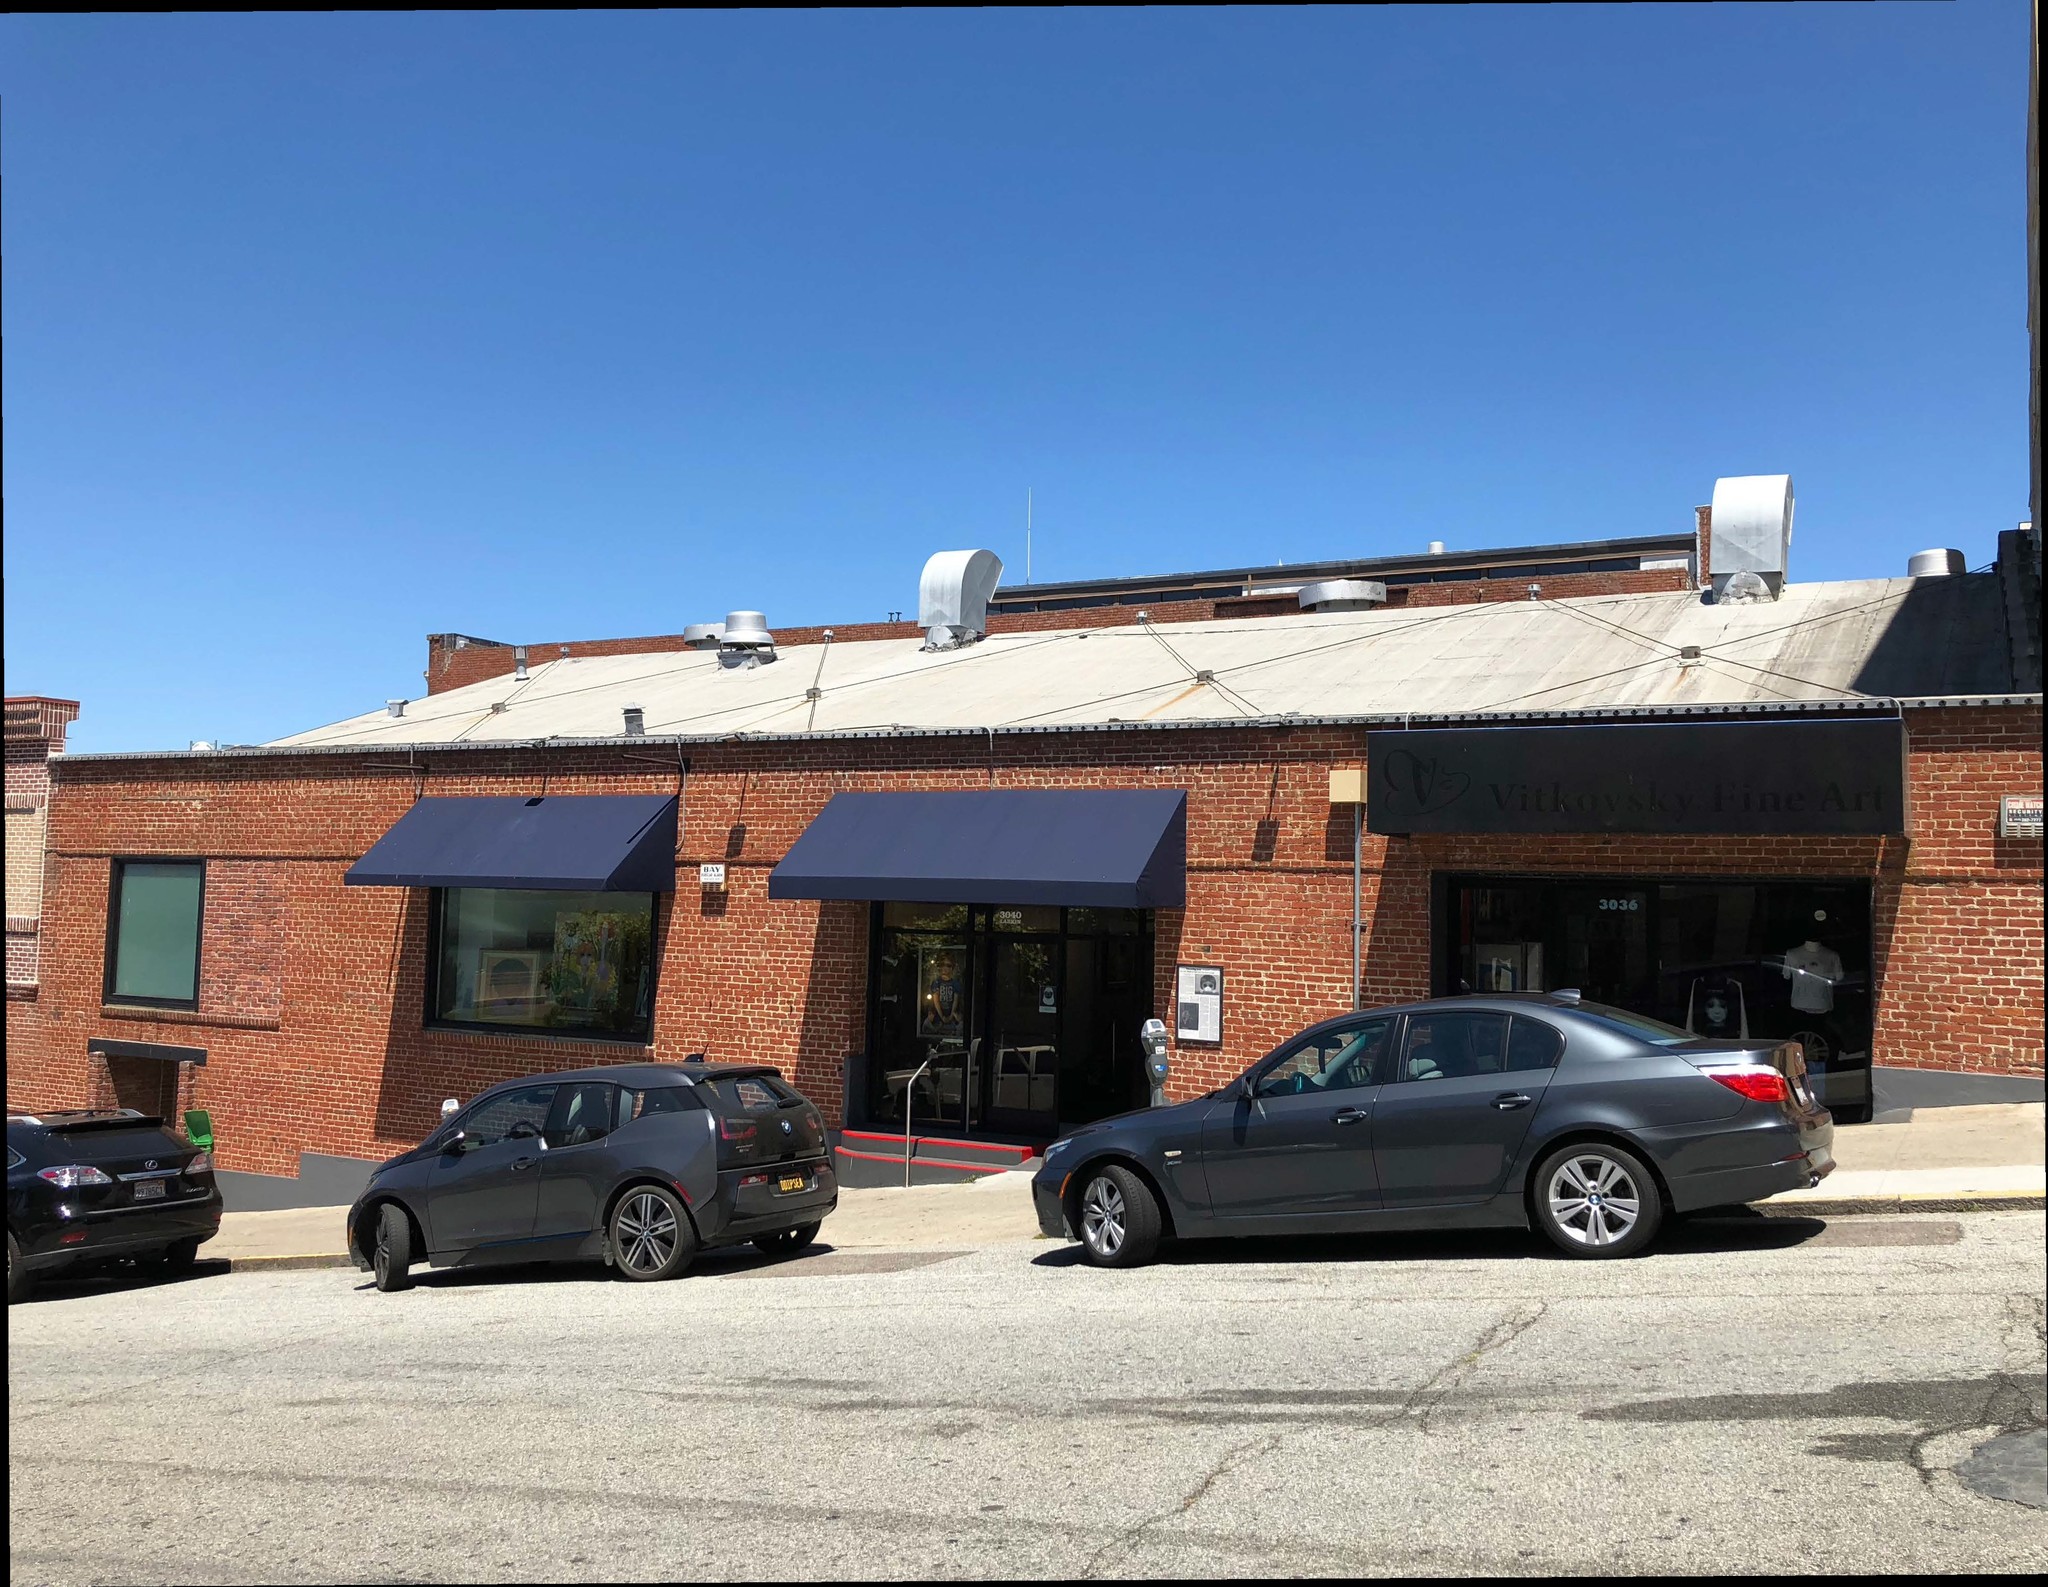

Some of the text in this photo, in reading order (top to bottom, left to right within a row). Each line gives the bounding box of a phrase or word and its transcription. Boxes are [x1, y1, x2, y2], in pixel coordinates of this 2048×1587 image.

[1488, 780, 1886, 824] Vitkovsky Fine Art
[1598, 898, 1639, 911] 3036
[999, 910, 1022, 919] 3040
[939, 985, 953, 995] BIG
